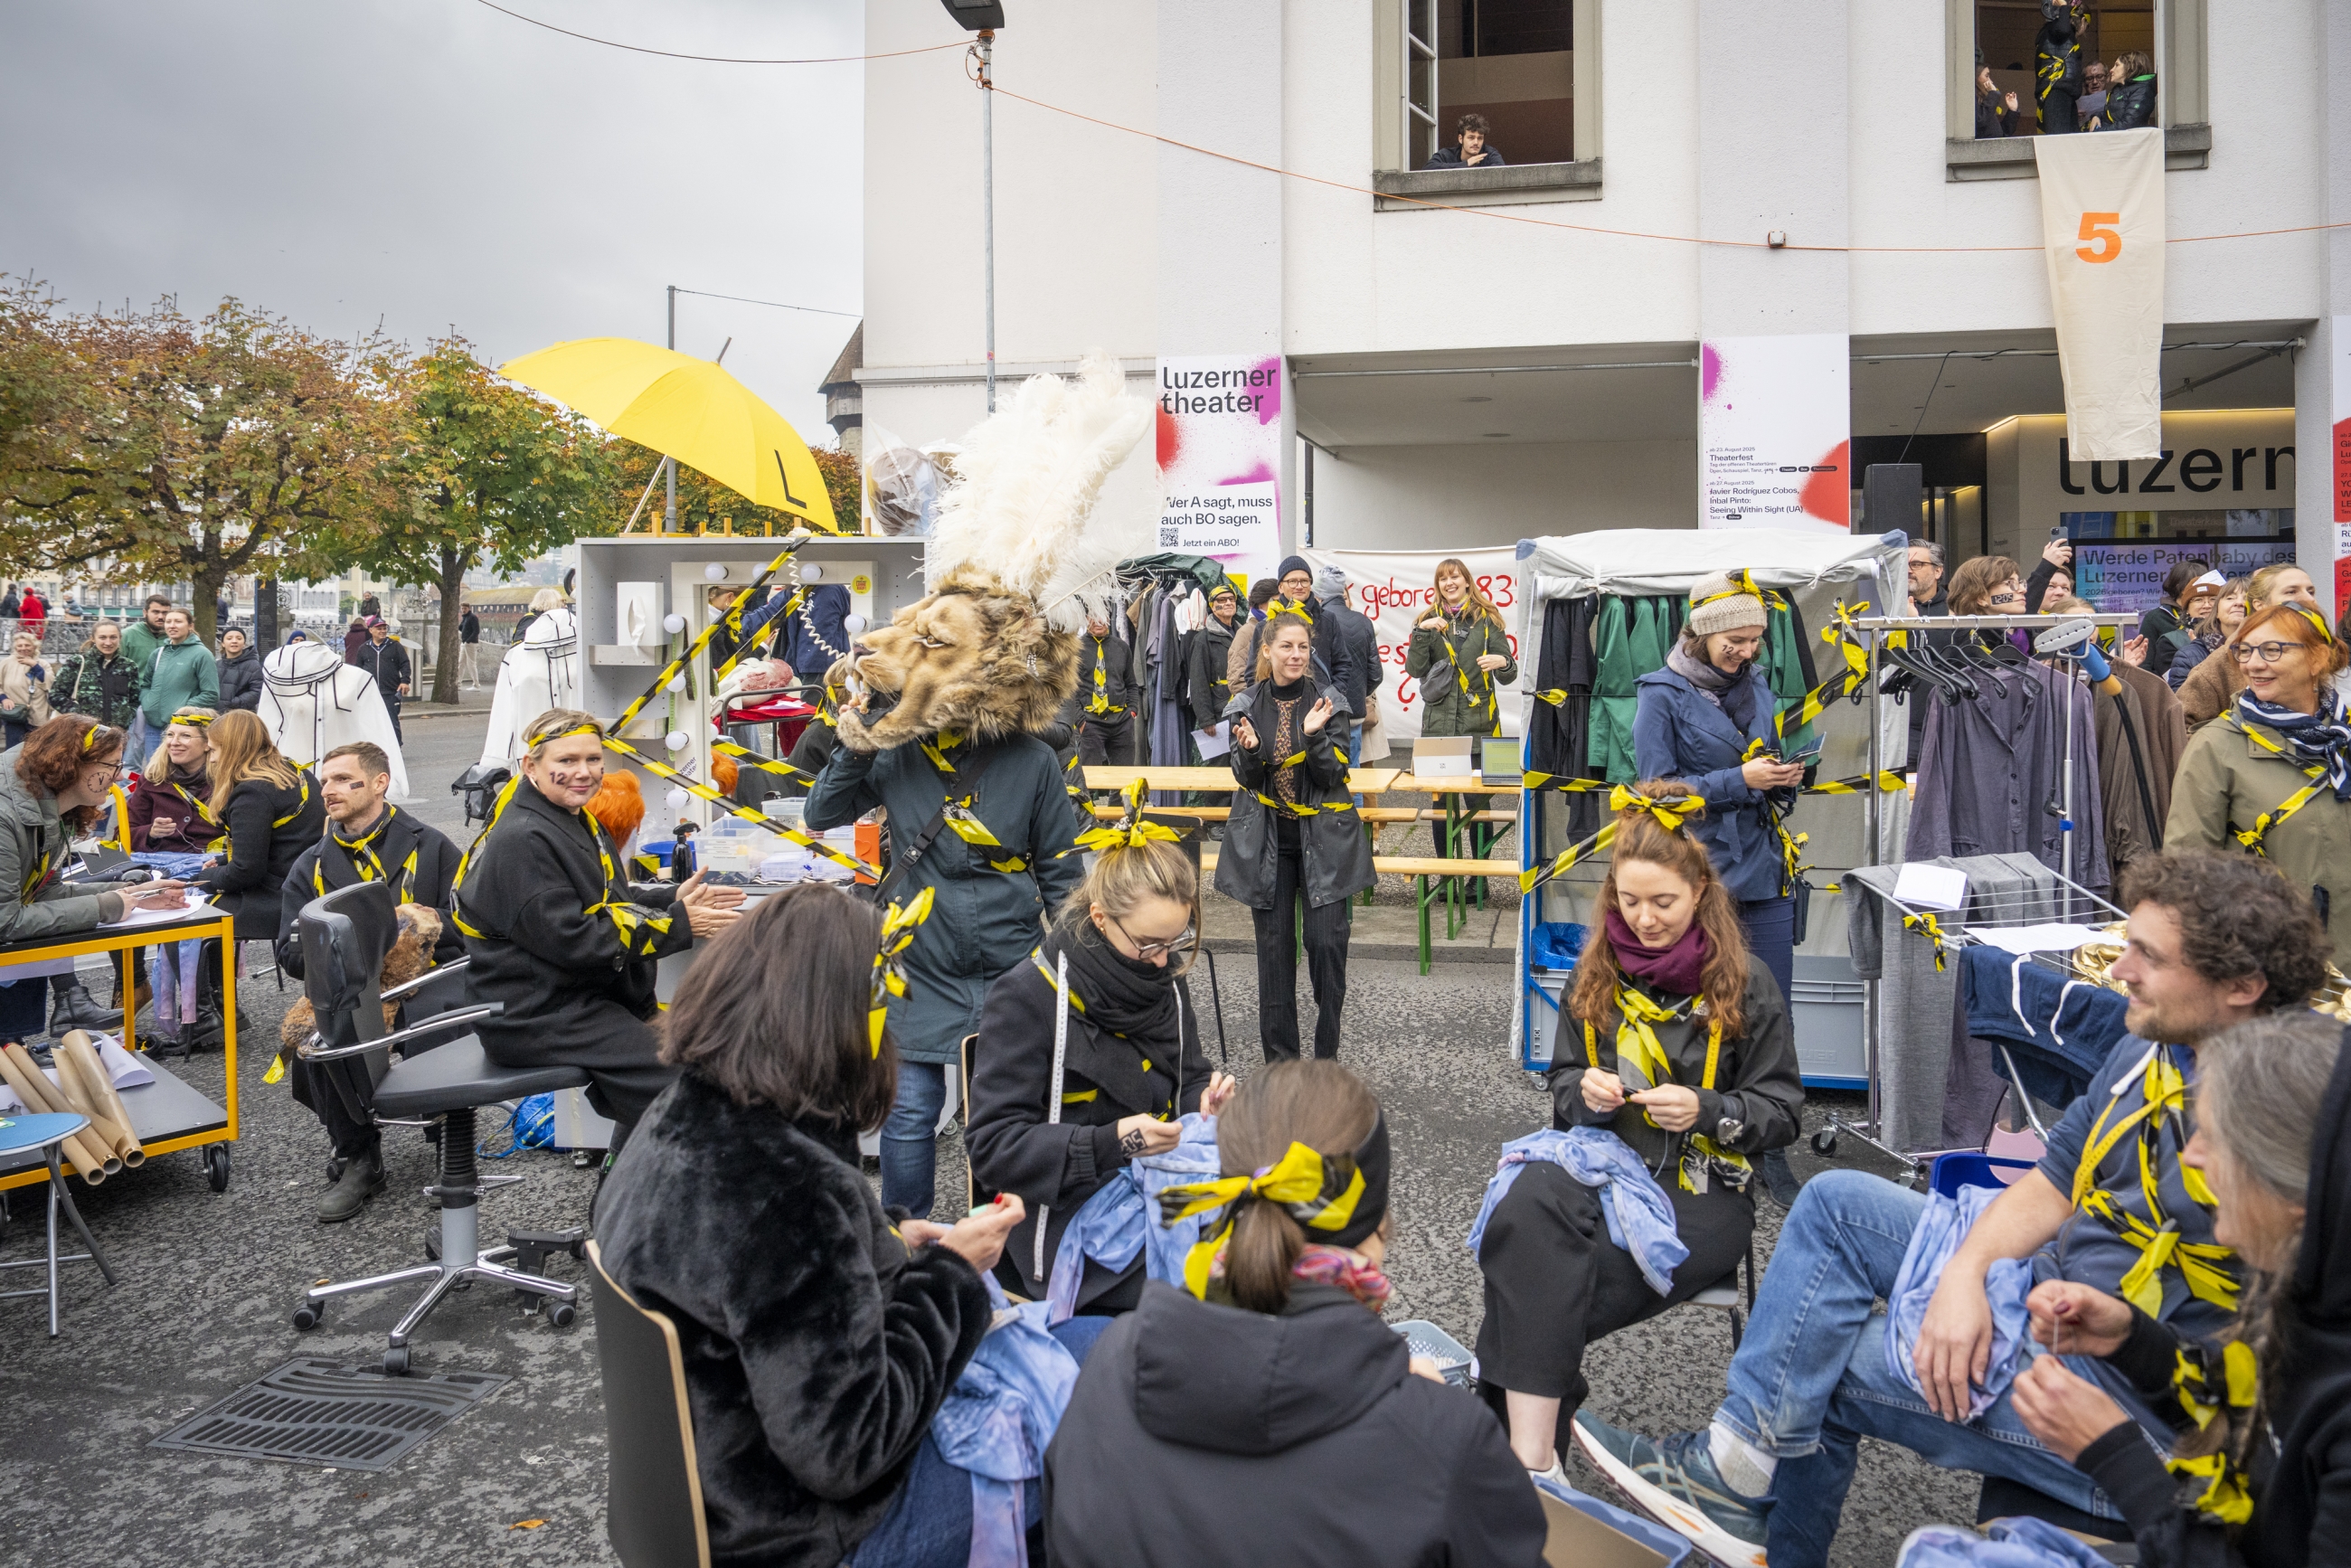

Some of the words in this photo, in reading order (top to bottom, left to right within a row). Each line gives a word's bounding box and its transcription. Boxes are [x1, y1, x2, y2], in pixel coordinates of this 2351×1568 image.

[2076, 212, 2122, 264] 5
[1163, 367, 1277, 389] luzerner
[1161, 392, 1264, 414] theater
[1733, 486, 1771, 496] Rodríguez
[1772, 486, 1800, 495] Cobos,
[1190, 496, 1201, 508] A
[1203, 496, 1235, 510] sagt,
[1238, 497, 1273, 506] muss
[1709, 506, 1736, 515] Seeing
[1764, 505, 1785, 515] Sight
[1786, 505, 1804, 514] (UA)
[1161, 514, 1192, 524] auch
[1195, 513, 1215, 524] BO
[1218, 515, 1260, 526] sagen.
[2083, 550, 2148, 564] Werde
[2154, 548, 2257, 567] Patenbaby
[2262, 548, 2296, 563] des
[2084, 568, 2167, 583] Luzerner
[2108, 588, 2145, 597] geboren?
[2107, 598, 2125, 606] lang
[1722, 644, 1734, 656] 12
[549, 770, 568, 785] 12
